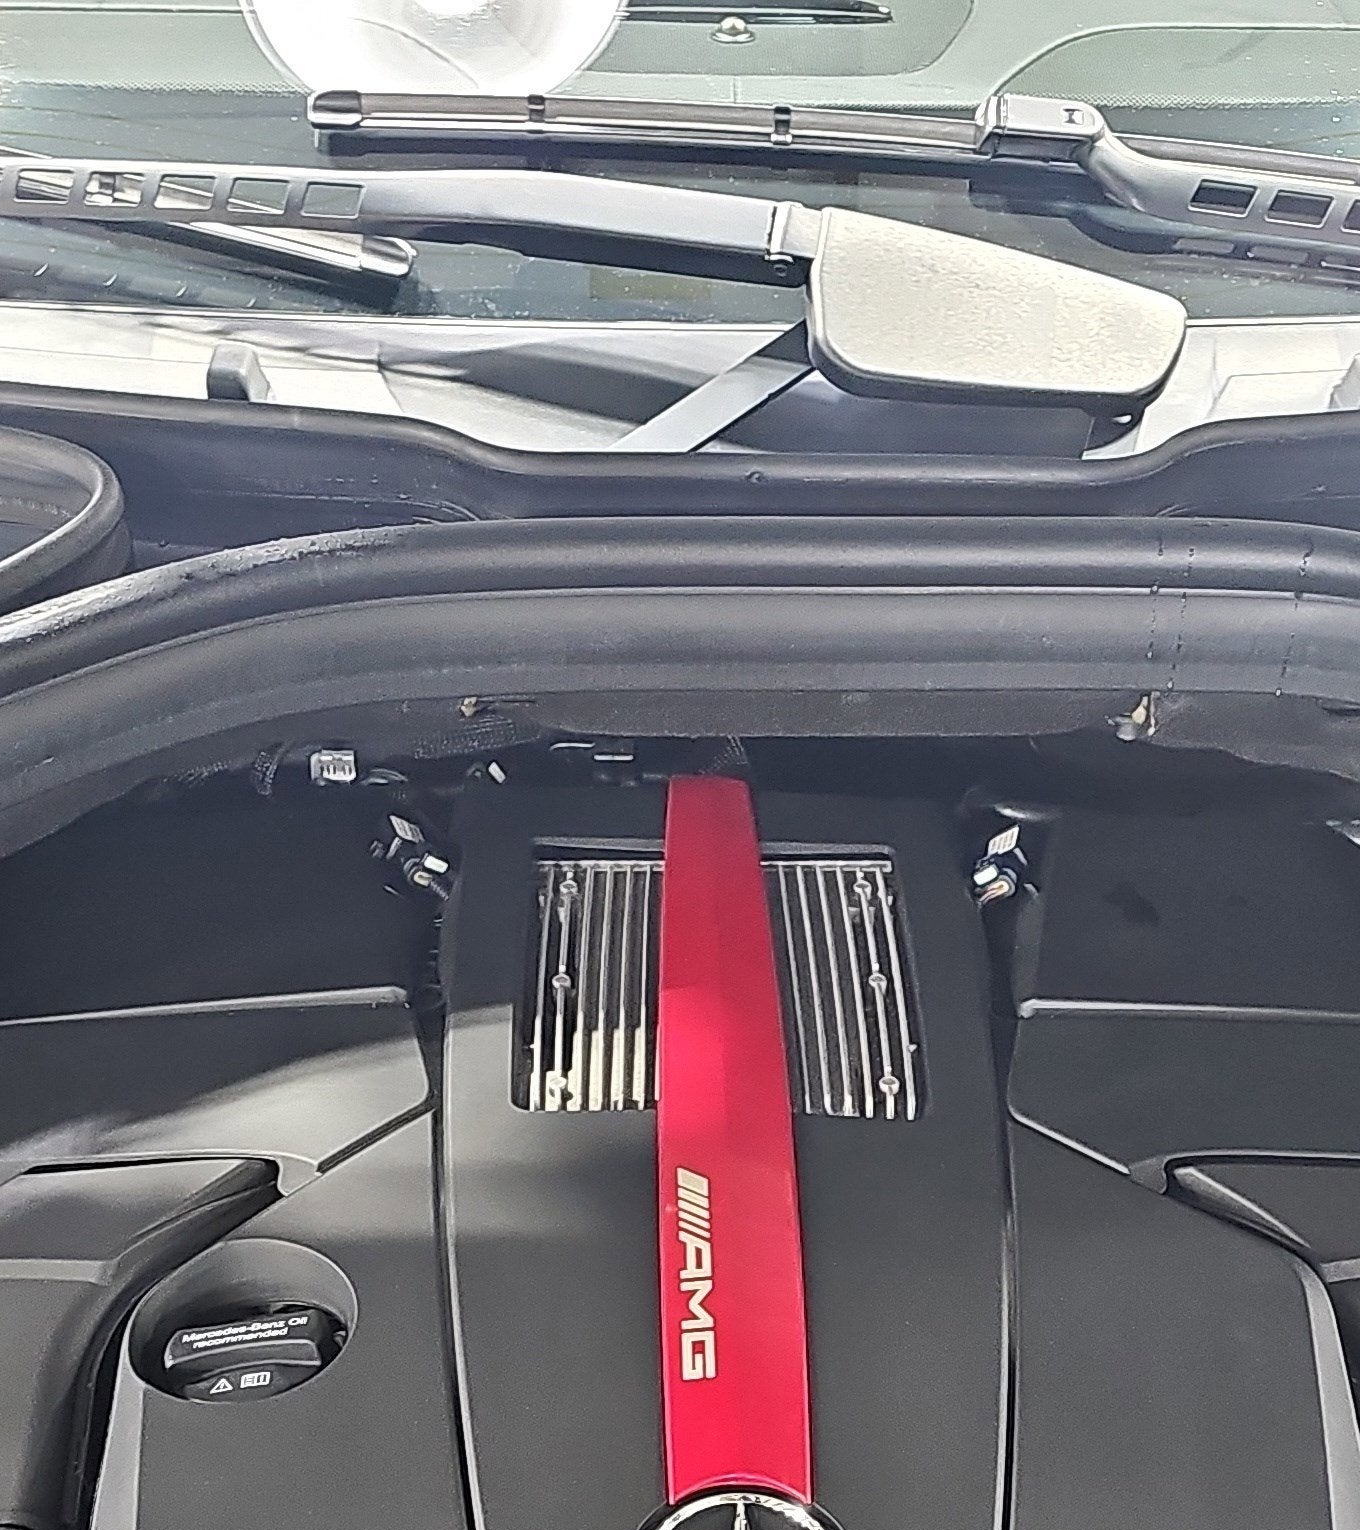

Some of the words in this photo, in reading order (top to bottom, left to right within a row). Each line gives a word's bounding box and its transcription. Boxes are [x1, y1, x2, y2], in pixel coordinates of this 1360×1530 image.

[678, 1230, 717, 1382] AMG
[181, 1319, 287, 1343] Mercedes-Benz
[288, 1316, 309, 1327] Oil
[192, 1327, 288, 1349] recommended
